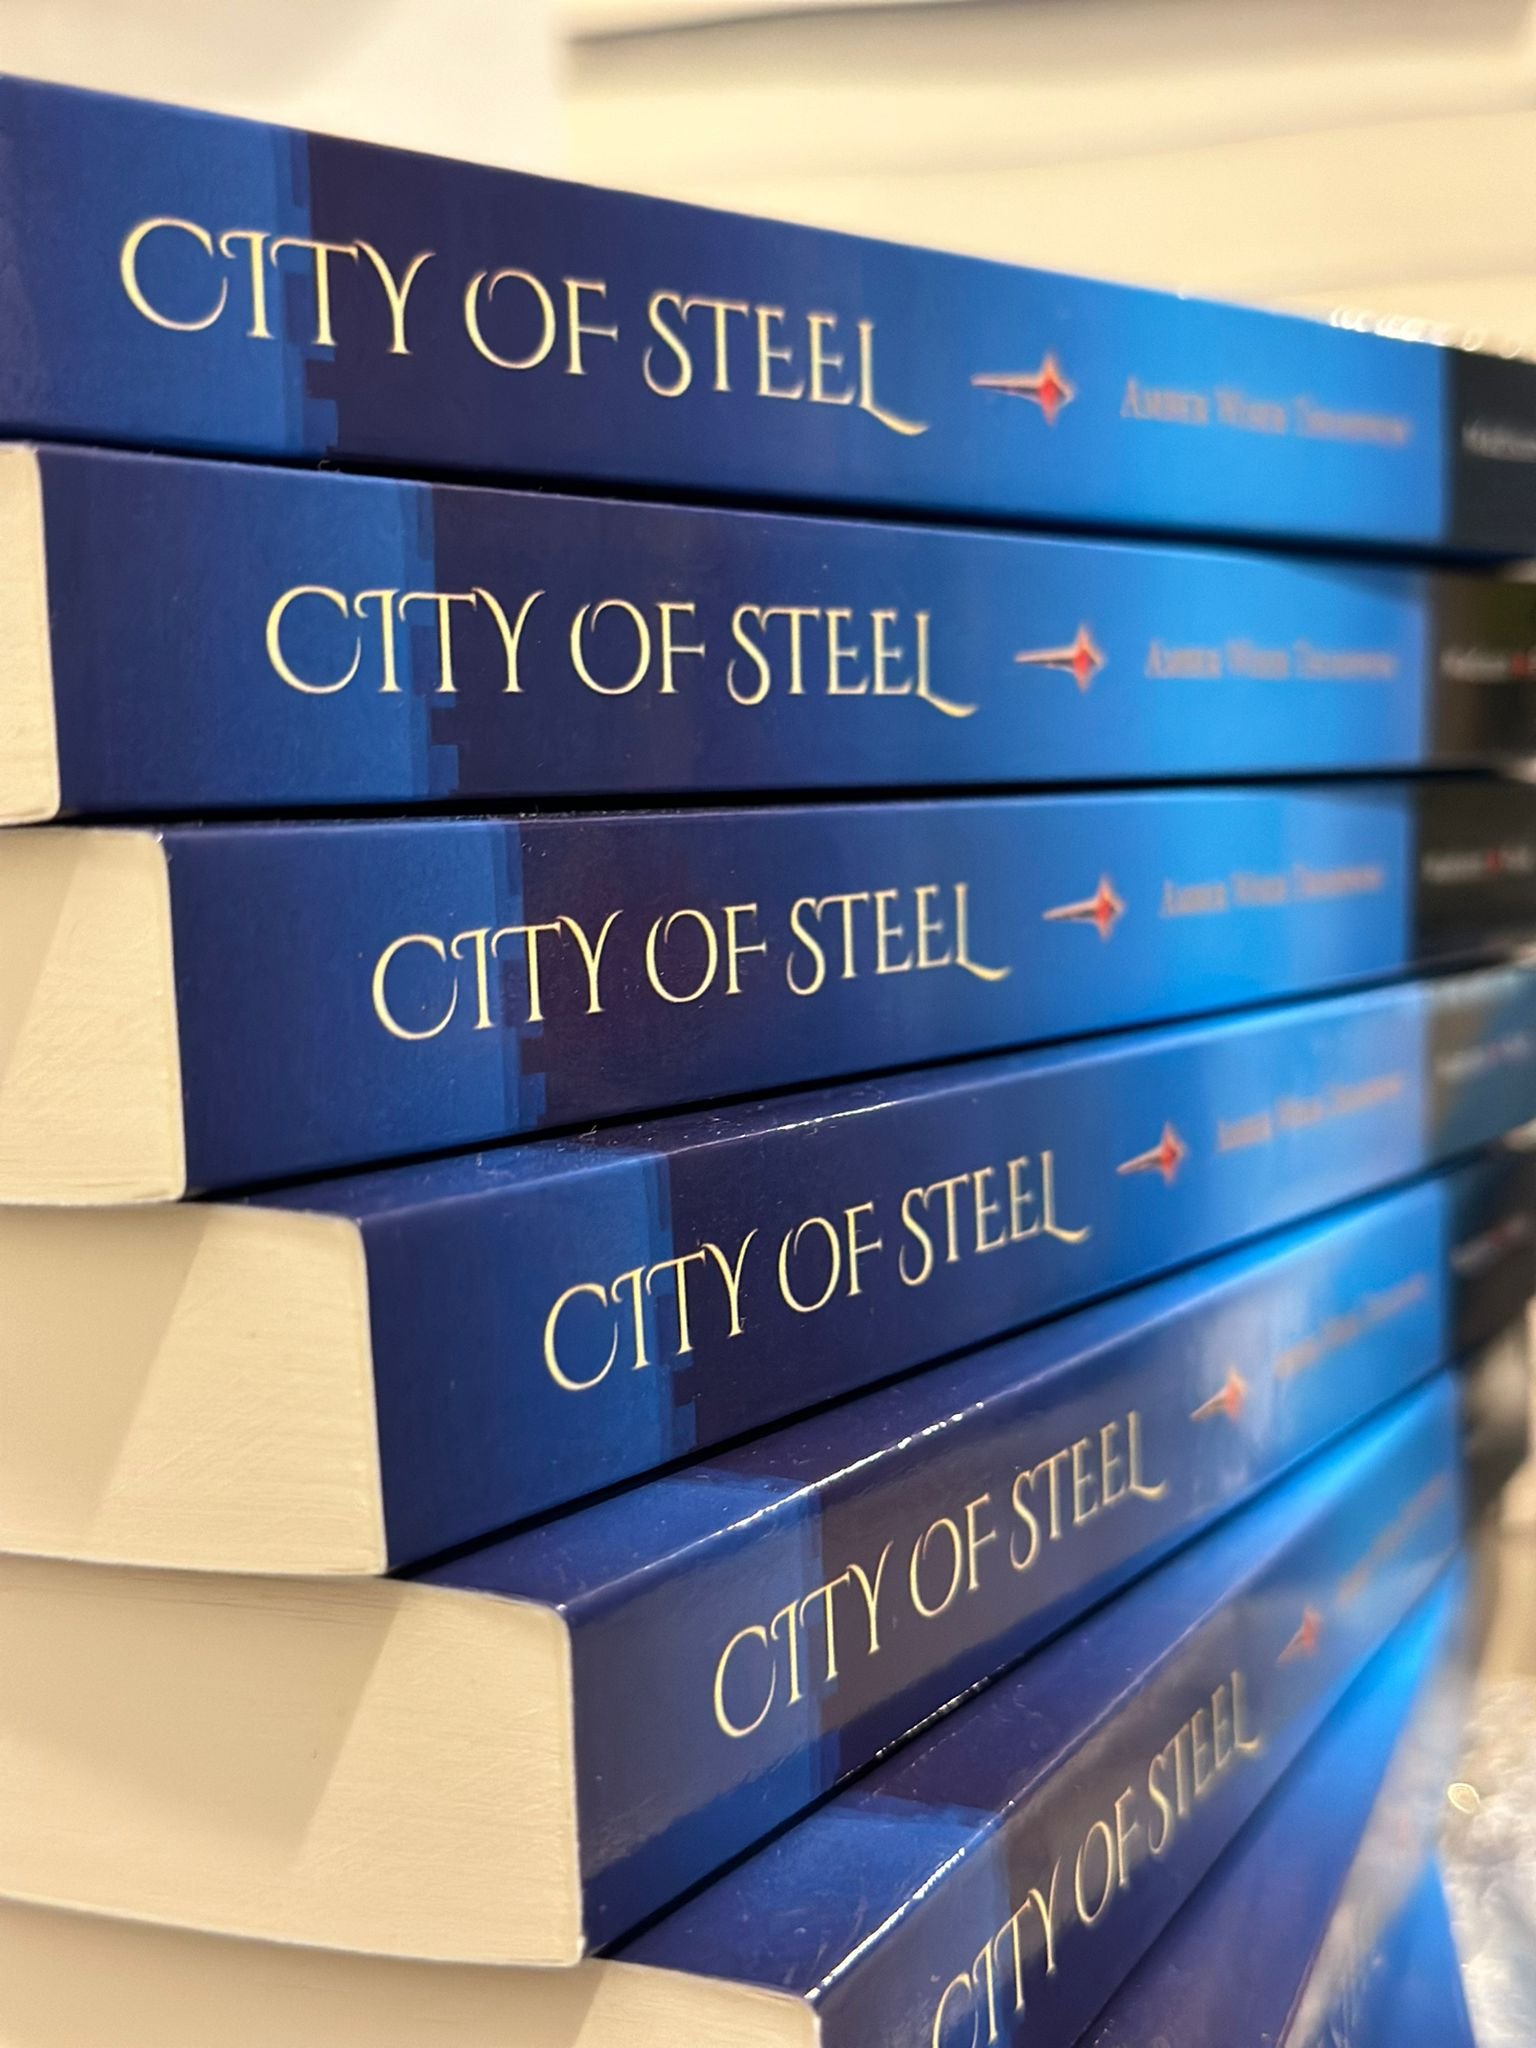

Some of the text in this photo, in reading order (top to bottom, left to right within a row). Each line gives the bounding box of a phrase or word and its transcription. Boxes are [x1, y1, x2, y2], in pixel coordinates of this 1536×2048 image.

[119, 216, 927, 436] CITY OF STEEL
[265, 585, 976, 718] CITY OF STEEL
[372, 883, 1010, 1041] CITY OF STEEL
[543, 1151, 1089, 1391] CITY OF STEEL
[713, 1541, 893, 1739] CITY
[909, 1492, 998, 1618] OF
[1009, 1411, 1167, 1572] STEEL
[1074, 1785, 1141, 1925] OF
[1147, 1670, 1264, 1855] STEEL
